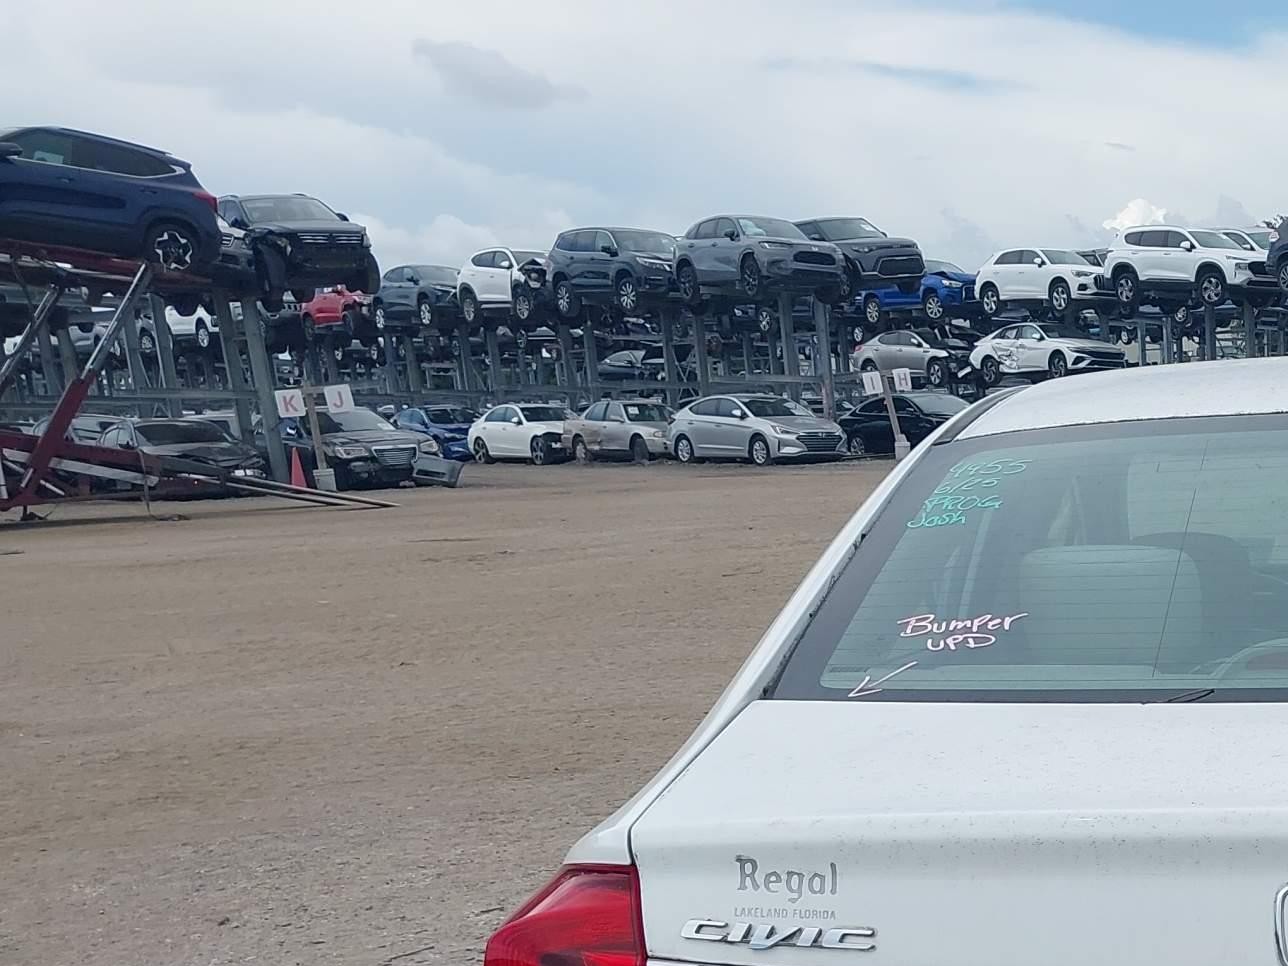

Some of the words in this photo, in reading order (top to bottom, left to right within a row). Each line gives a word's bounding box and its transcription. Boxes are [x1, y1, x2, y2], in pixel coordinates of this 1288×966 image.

[282, 394, 299, 412] K
[332, 391, 344, 408] J
[735, 855, 838, 903] Regal
[734, 906, 789, 919] LAKELAND
[792, 907, 837, 920] FLORIDA
[680, 919, 877, 951] CIVIC
